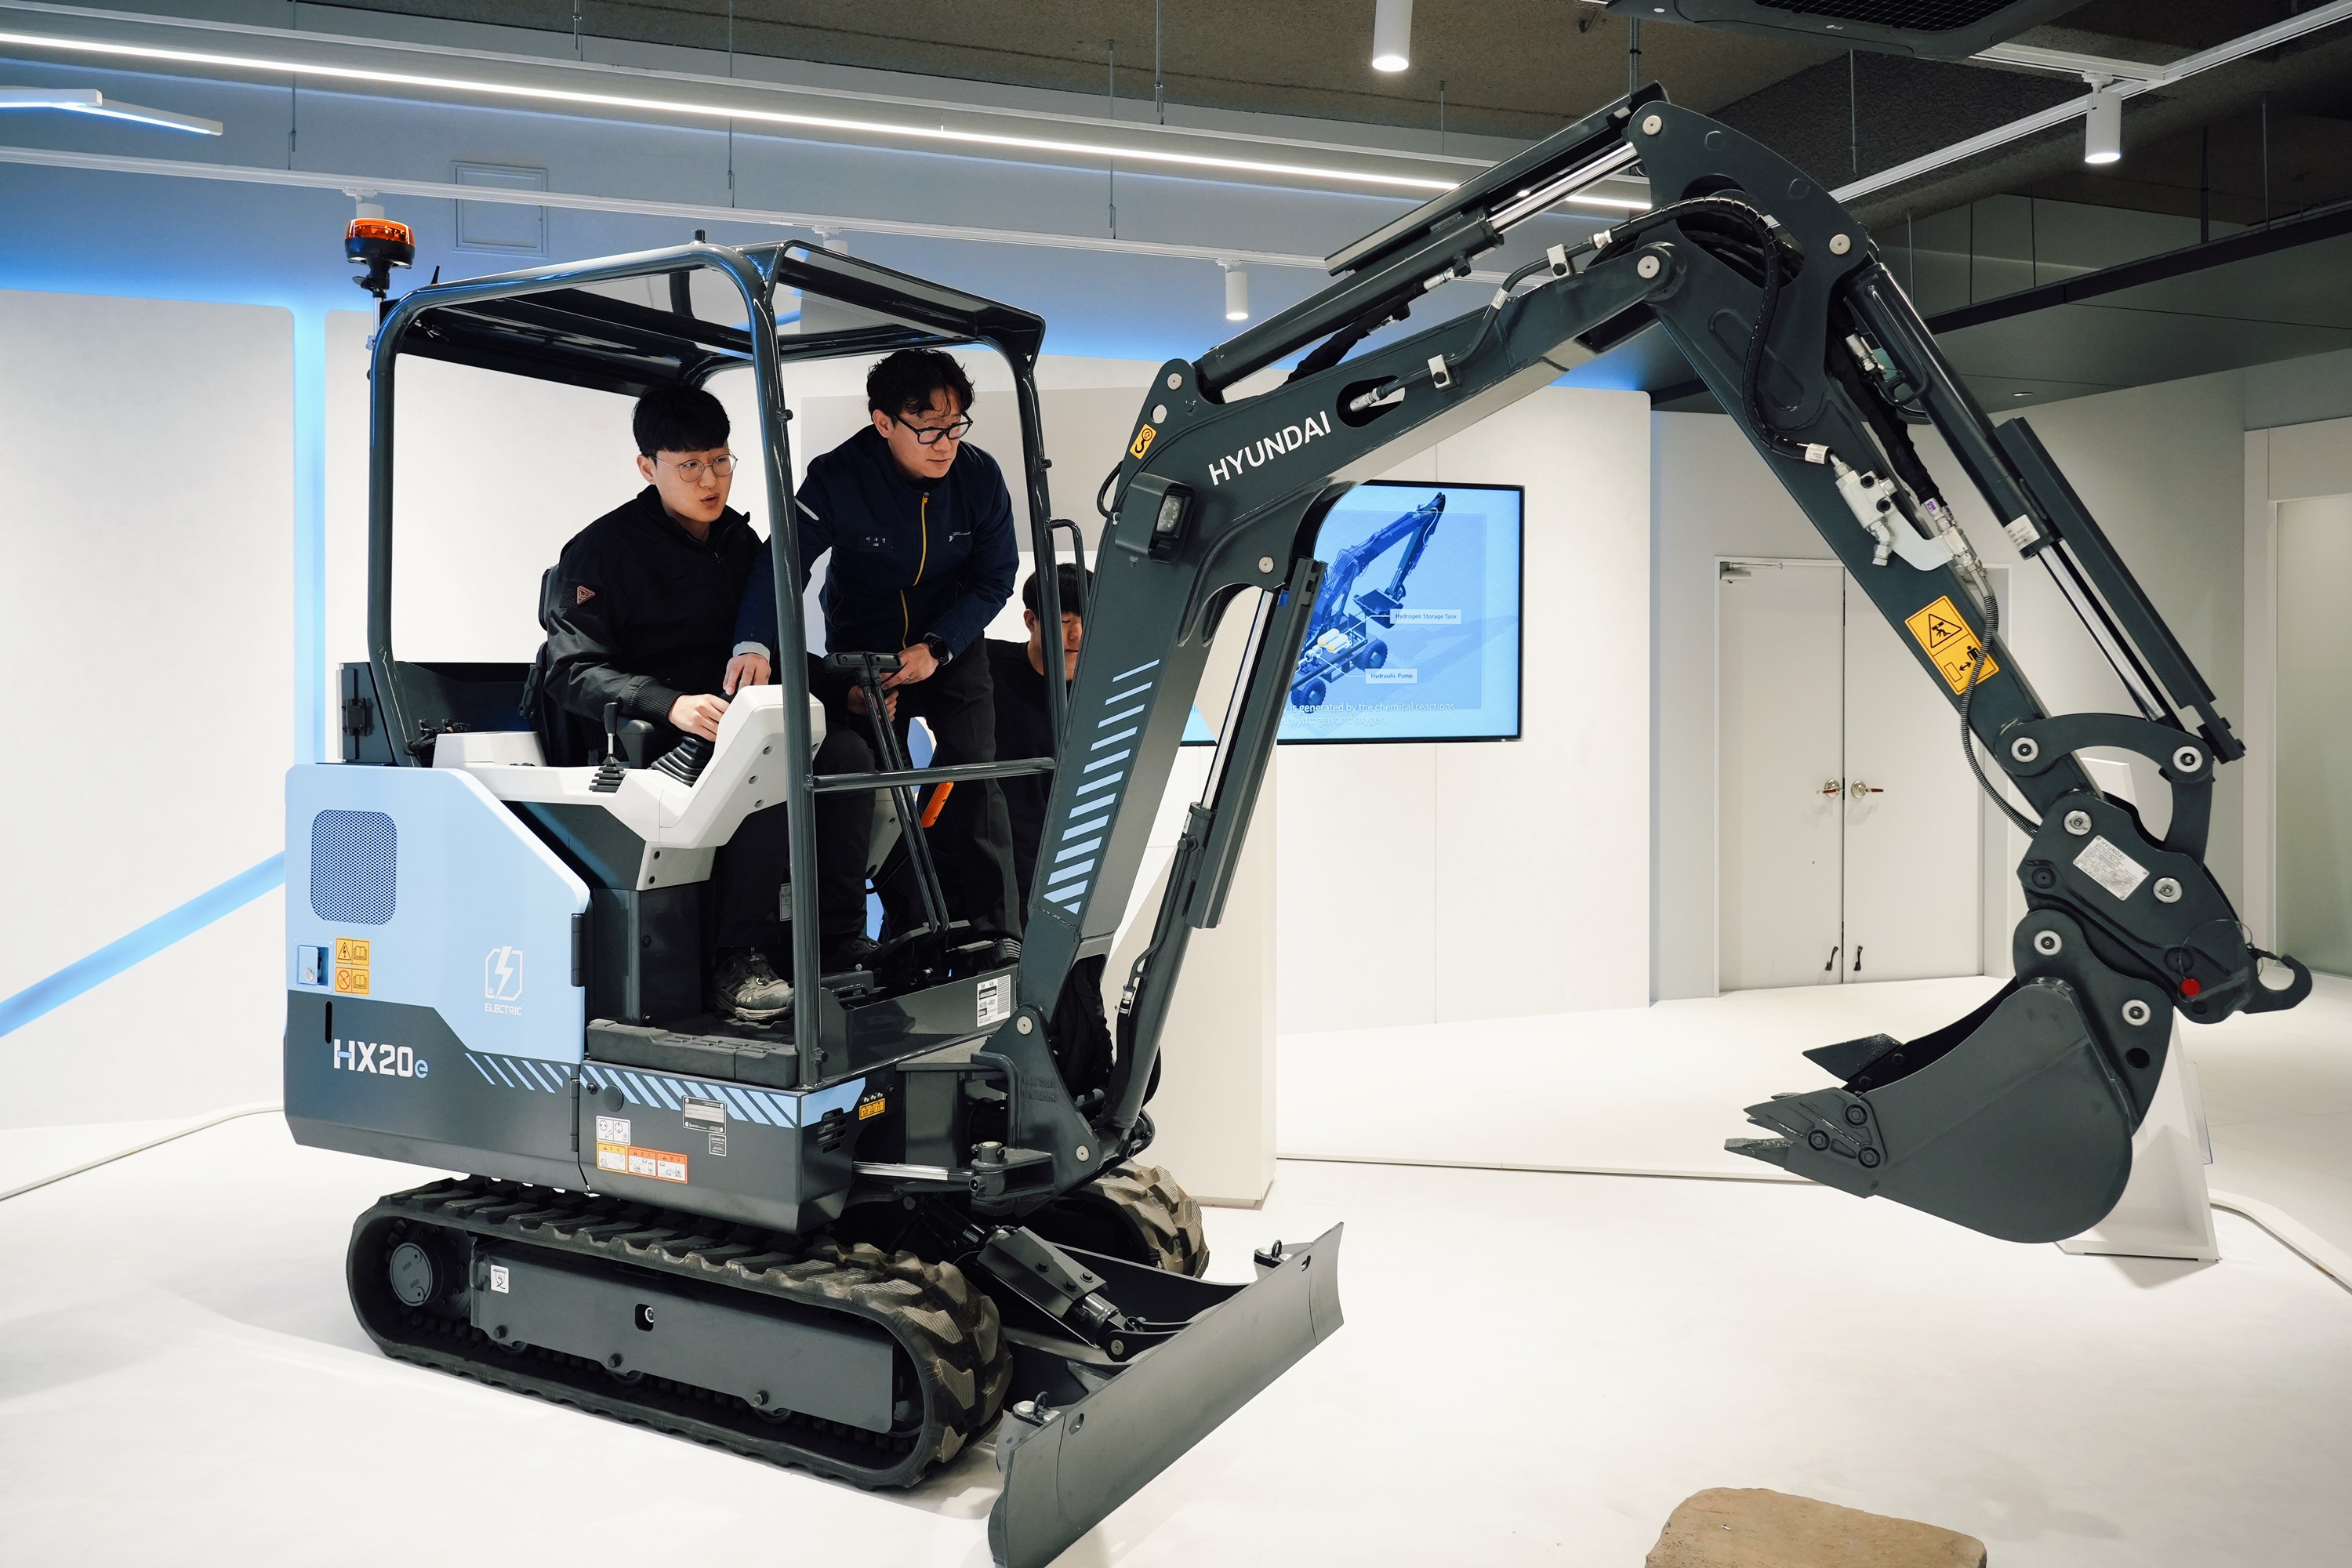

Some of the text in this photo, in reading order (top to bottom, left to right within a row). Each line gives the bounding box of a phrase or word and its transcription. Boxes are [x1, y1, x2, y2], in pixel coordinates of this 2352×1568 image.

[1208, 411, 1331, 486] HYUNDAI
[1290, 702, 1298, 712] is
[1299, 702, 1344, 715] generated
[1345, 702, 1356, 714] by
[1359, 702, 1373, 712] the
[1375, 702, 1414, 712] chemical
[1415, 702, 1454, 712] reactions
[1291, 715, 1333, 727] hydrogen
[1335, 715, 1352, 724] and
[1354, 717, 1388, 726] oxygen.
[2101, 840, 2126, 860] HYUNDAI
[485, 1003, 522, 1015] ELECTRIC
[334, 1039, 429, 1079] HX20e
